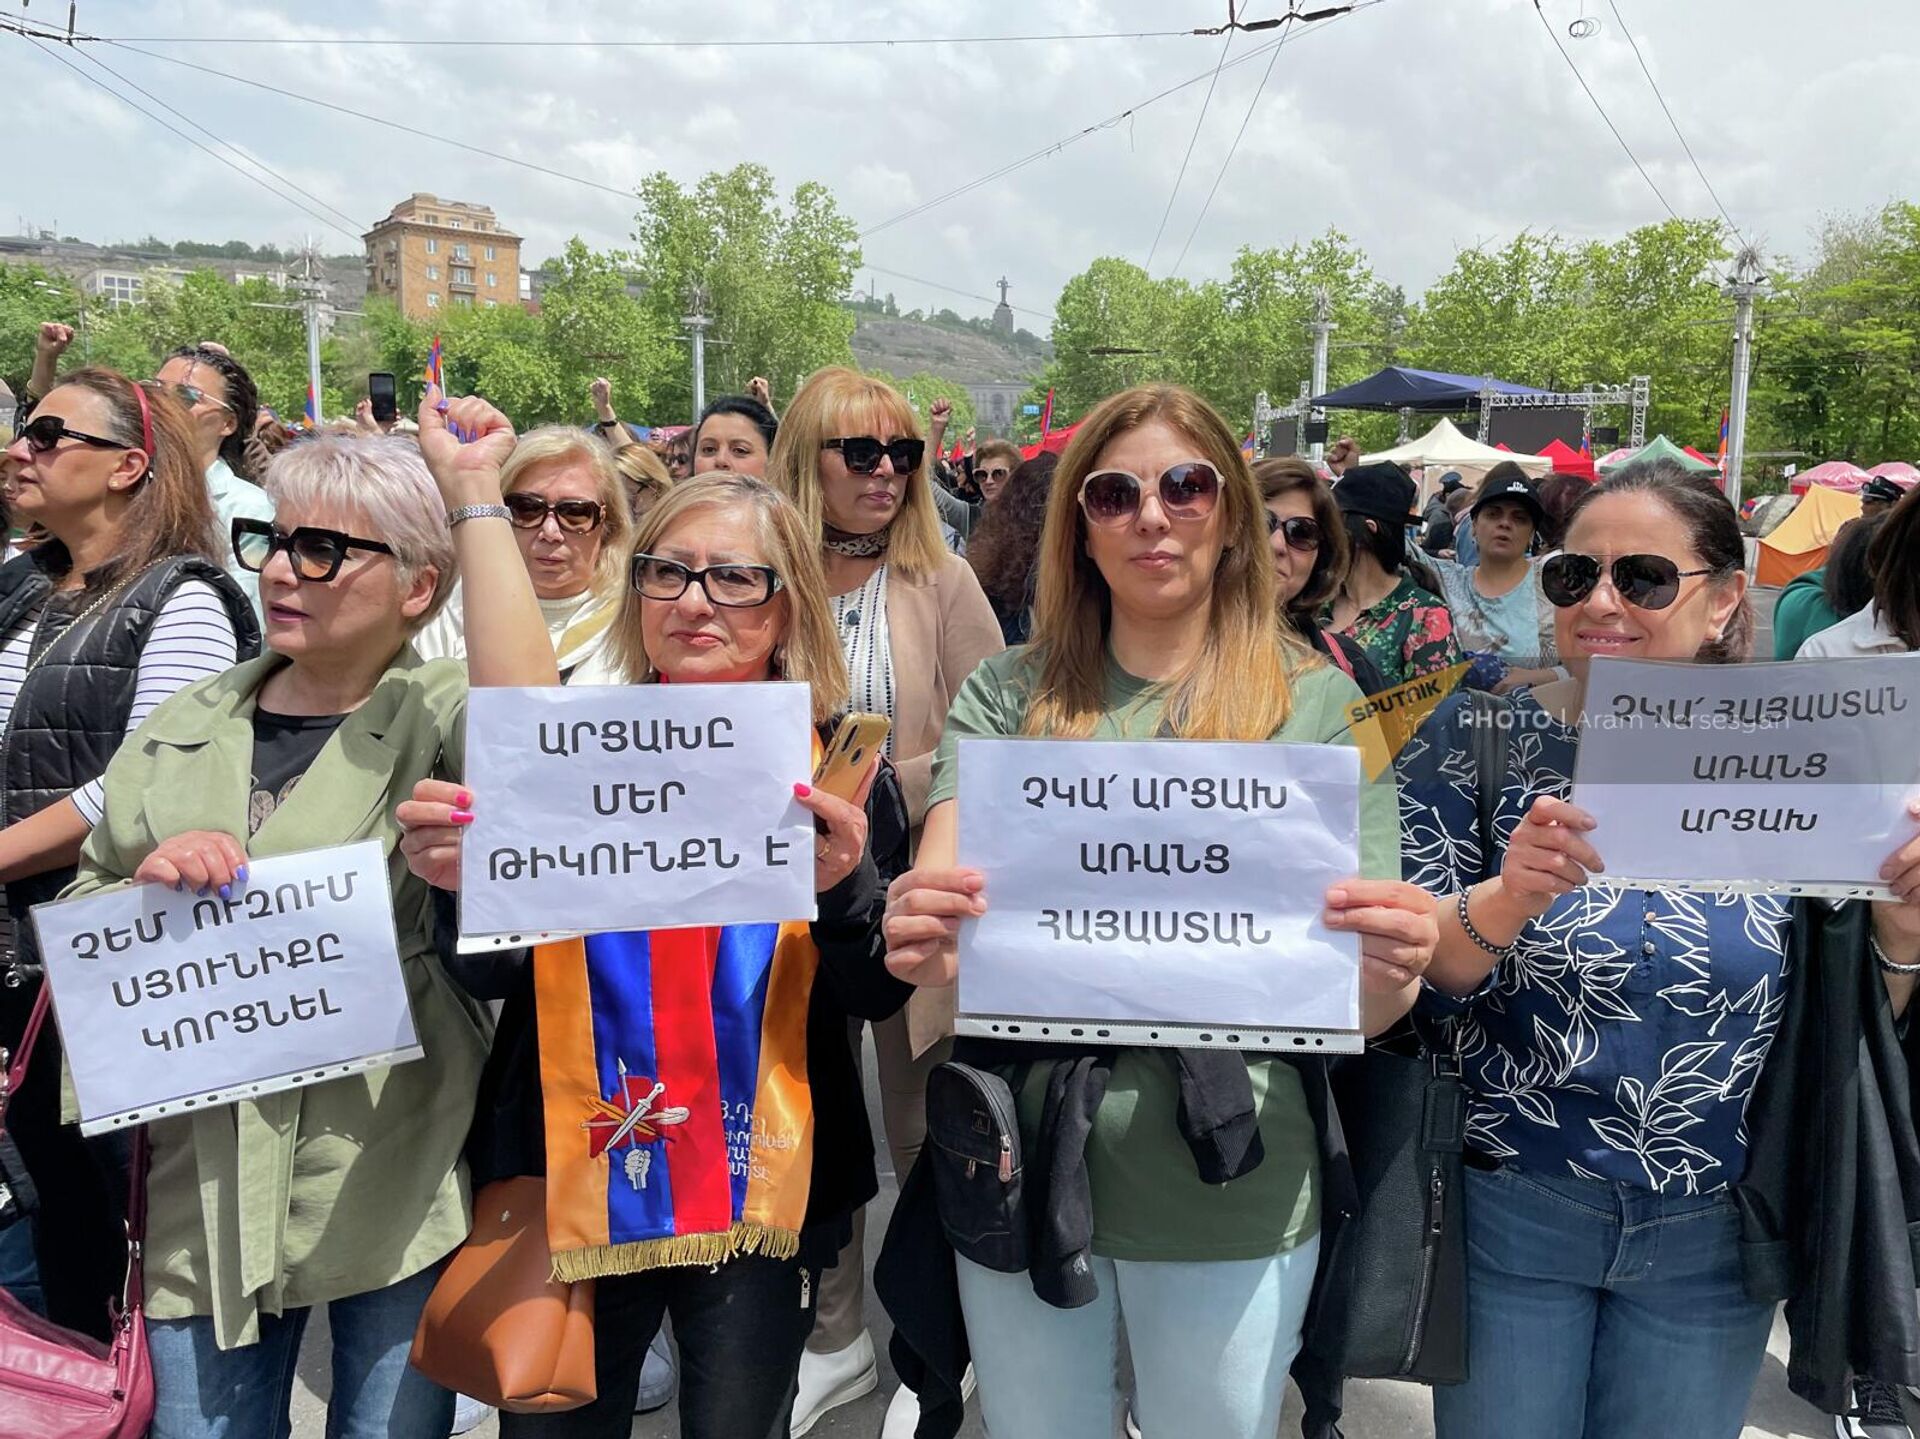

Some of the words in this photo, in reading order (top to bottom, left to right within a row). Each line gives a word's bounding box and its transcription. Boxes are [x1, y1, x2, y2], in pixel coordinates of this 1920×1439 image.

[1713, 687, 1907, 724] ՀԱՅԱՍՏԱՆ
[539, 716, 734, 757] ԱՐՑԱԽԸ
[1693, 753, 1828, 781] ԱՌԱՆՑ
[593, 781, 685, 816] ՄԵՐ
[1133, 777, 1287, 812] ԱՐՑԱԽ
[1681, 808, 1818, 834] ԱՐՑԱԽ
[489, 838, 740, 881] ԹԻԿՈՒՆՔՆ
[766, 836, 790, 866] Է
[1080, 843, 1230, 876] ԱՌԱՆՑ
[71, 910, 167, 960] ՉԵՄ
[192, 871, 358, 930] ՈՒԶՈՒՄ
[1036, 908, 1272, 947] ՀԱՅԱՍՏԱՆ
[112, 932, 344, 1007] ՍՅՈՒՆԻՔԸ
[141, 988, 342, 1051] ԿՈՐՑՆԵԼ
